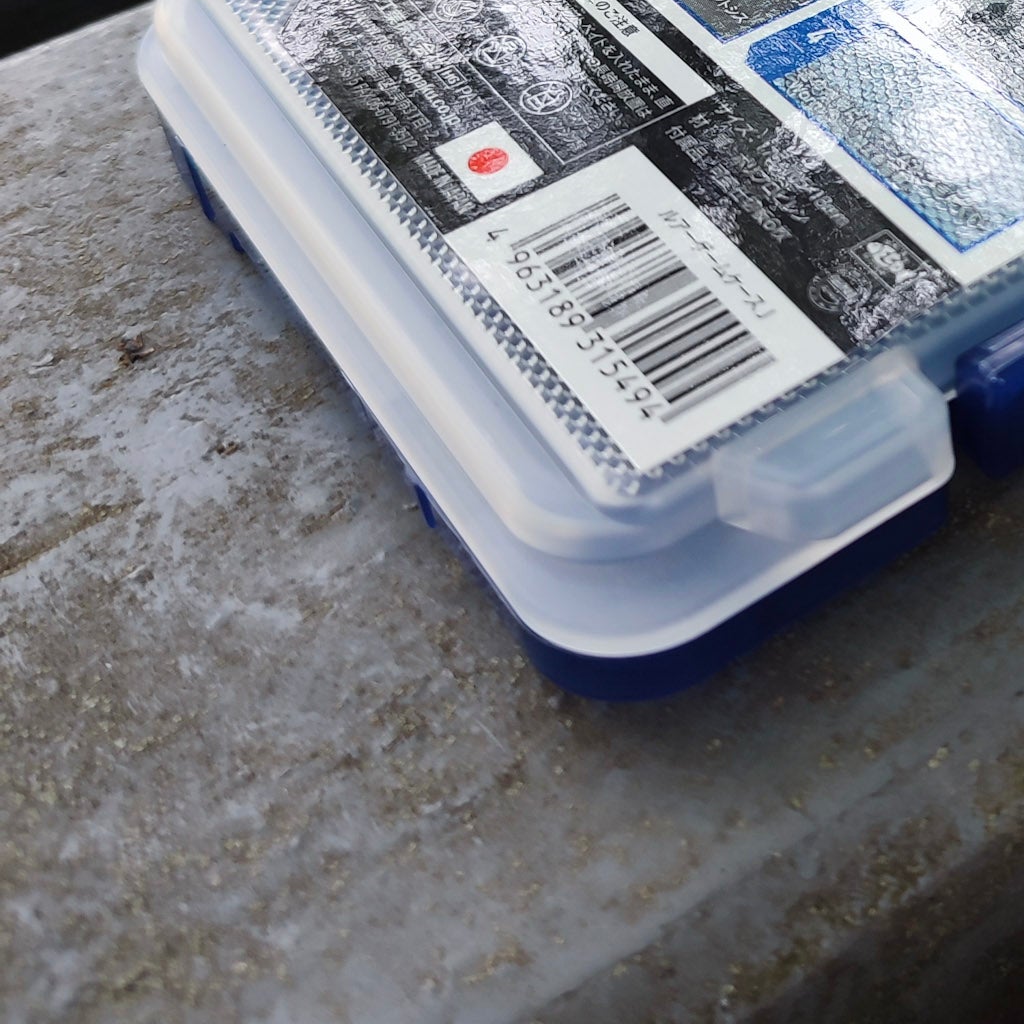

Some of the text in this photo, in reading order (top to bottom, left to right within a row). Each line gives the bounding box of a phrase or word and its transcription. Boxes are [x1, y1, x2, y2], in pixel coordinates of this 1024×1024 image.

[479, 223, 512, 244] 4
[498, 247, 592, 333] 963189
[570, 329, 671, 424] 315494
